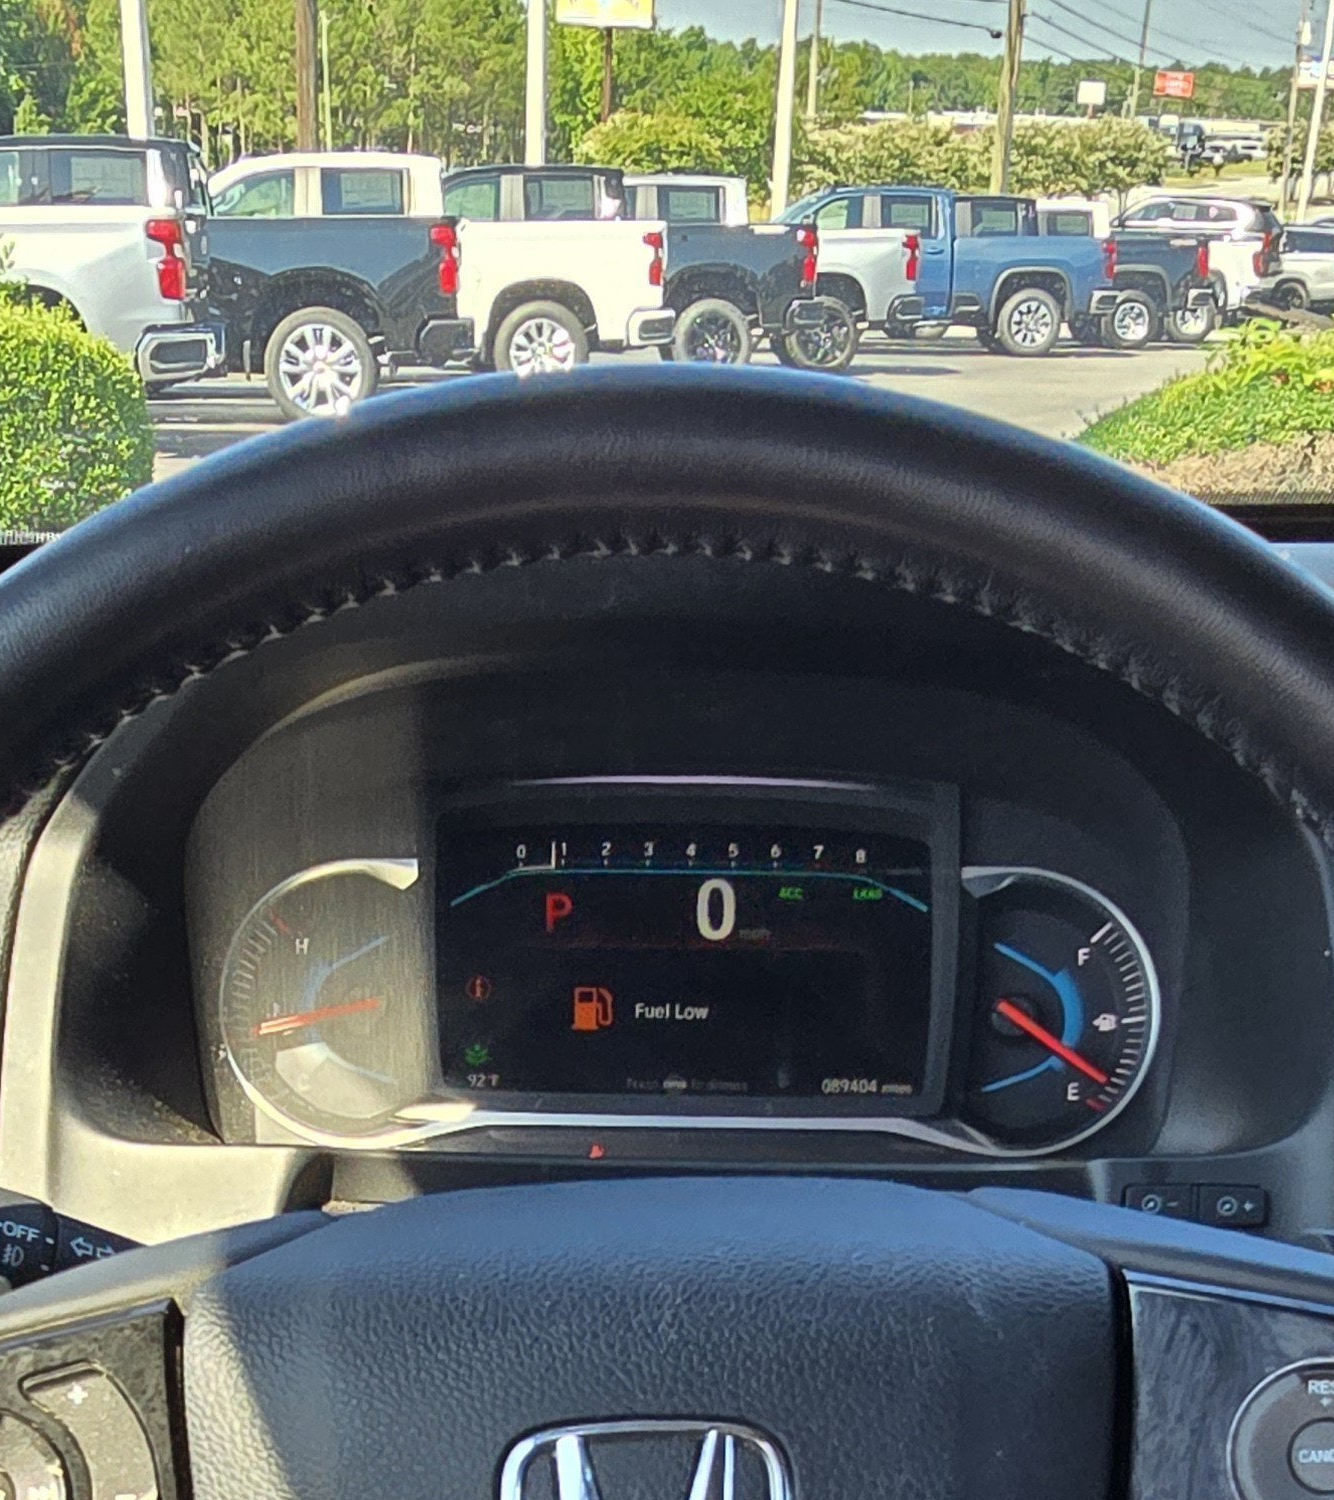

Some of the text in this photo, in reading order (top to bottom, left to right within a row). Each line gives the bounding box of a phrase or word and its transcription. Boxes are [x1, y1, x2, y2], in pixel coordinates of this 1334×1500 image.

[601, 842, 612, 856] 2
[644, 842, 654, 857] 3
[686, 843, 696, 857] 4
[728, 843, 739, 857] 5
[770, 843, 781, 858] 6
[812, 845, 824, 860] 7
[546, 893, 573, 932] P
[696, 878, 736, 941] 0
[1078, 947, 1090, 966] F
[634, 1003, 709, 1021] Fuel Low
[1066, 1082, 1080, 1101] E
[2, 1220, 40, 1243] OFF
